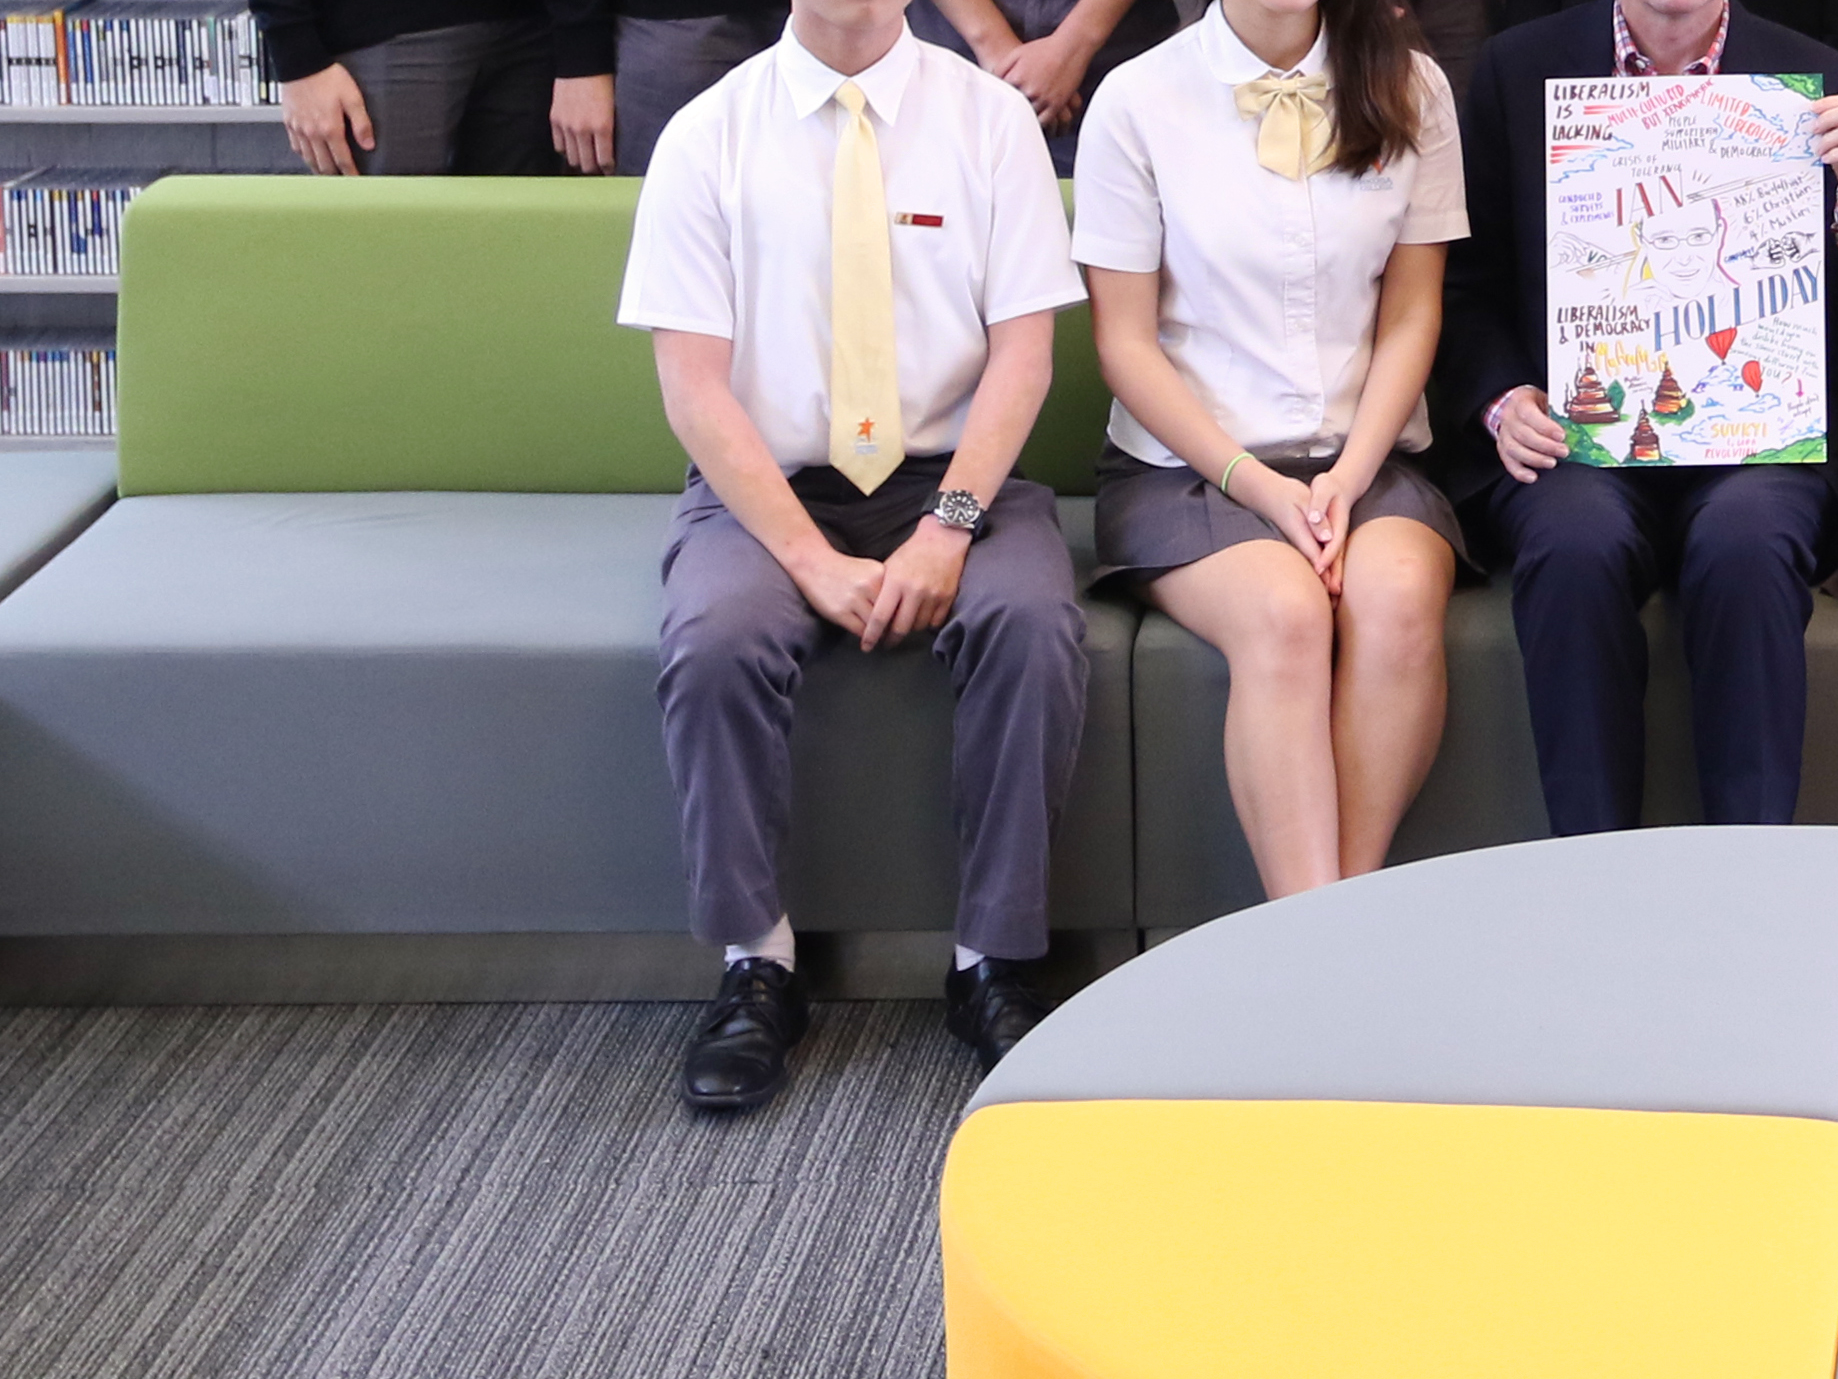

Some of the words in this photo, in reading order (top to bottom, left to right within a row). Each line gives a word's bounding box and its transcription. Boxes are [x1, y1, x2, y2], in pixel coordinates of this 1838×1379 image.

[1553, 81, 1650, 101] LIBERALISM
[1556, 104, 1573, 119] IS
[1699, 91, 1752, 118] LIMITED
[1641, 112, 1663, 130] BUT
[1723, 114, 1788, 148] LIBERALISM
[1552, 124, 1614, 141] LACKING
[1611, 154, 1643, 168] CRISIS
[1646, 154, 1658, 164] OF
[1719, 145, 1775, 160] DEMOCRACY
[1616, 168, 1684, 227] IAN
[1557, 304, 1640, 325] LIBERALISM
[1653, 261, 1821, 353] HOLLIDAY
[1574, 318, 1651, 339] DEMOCRACY
[1580, 340, 1596, 353] IN
